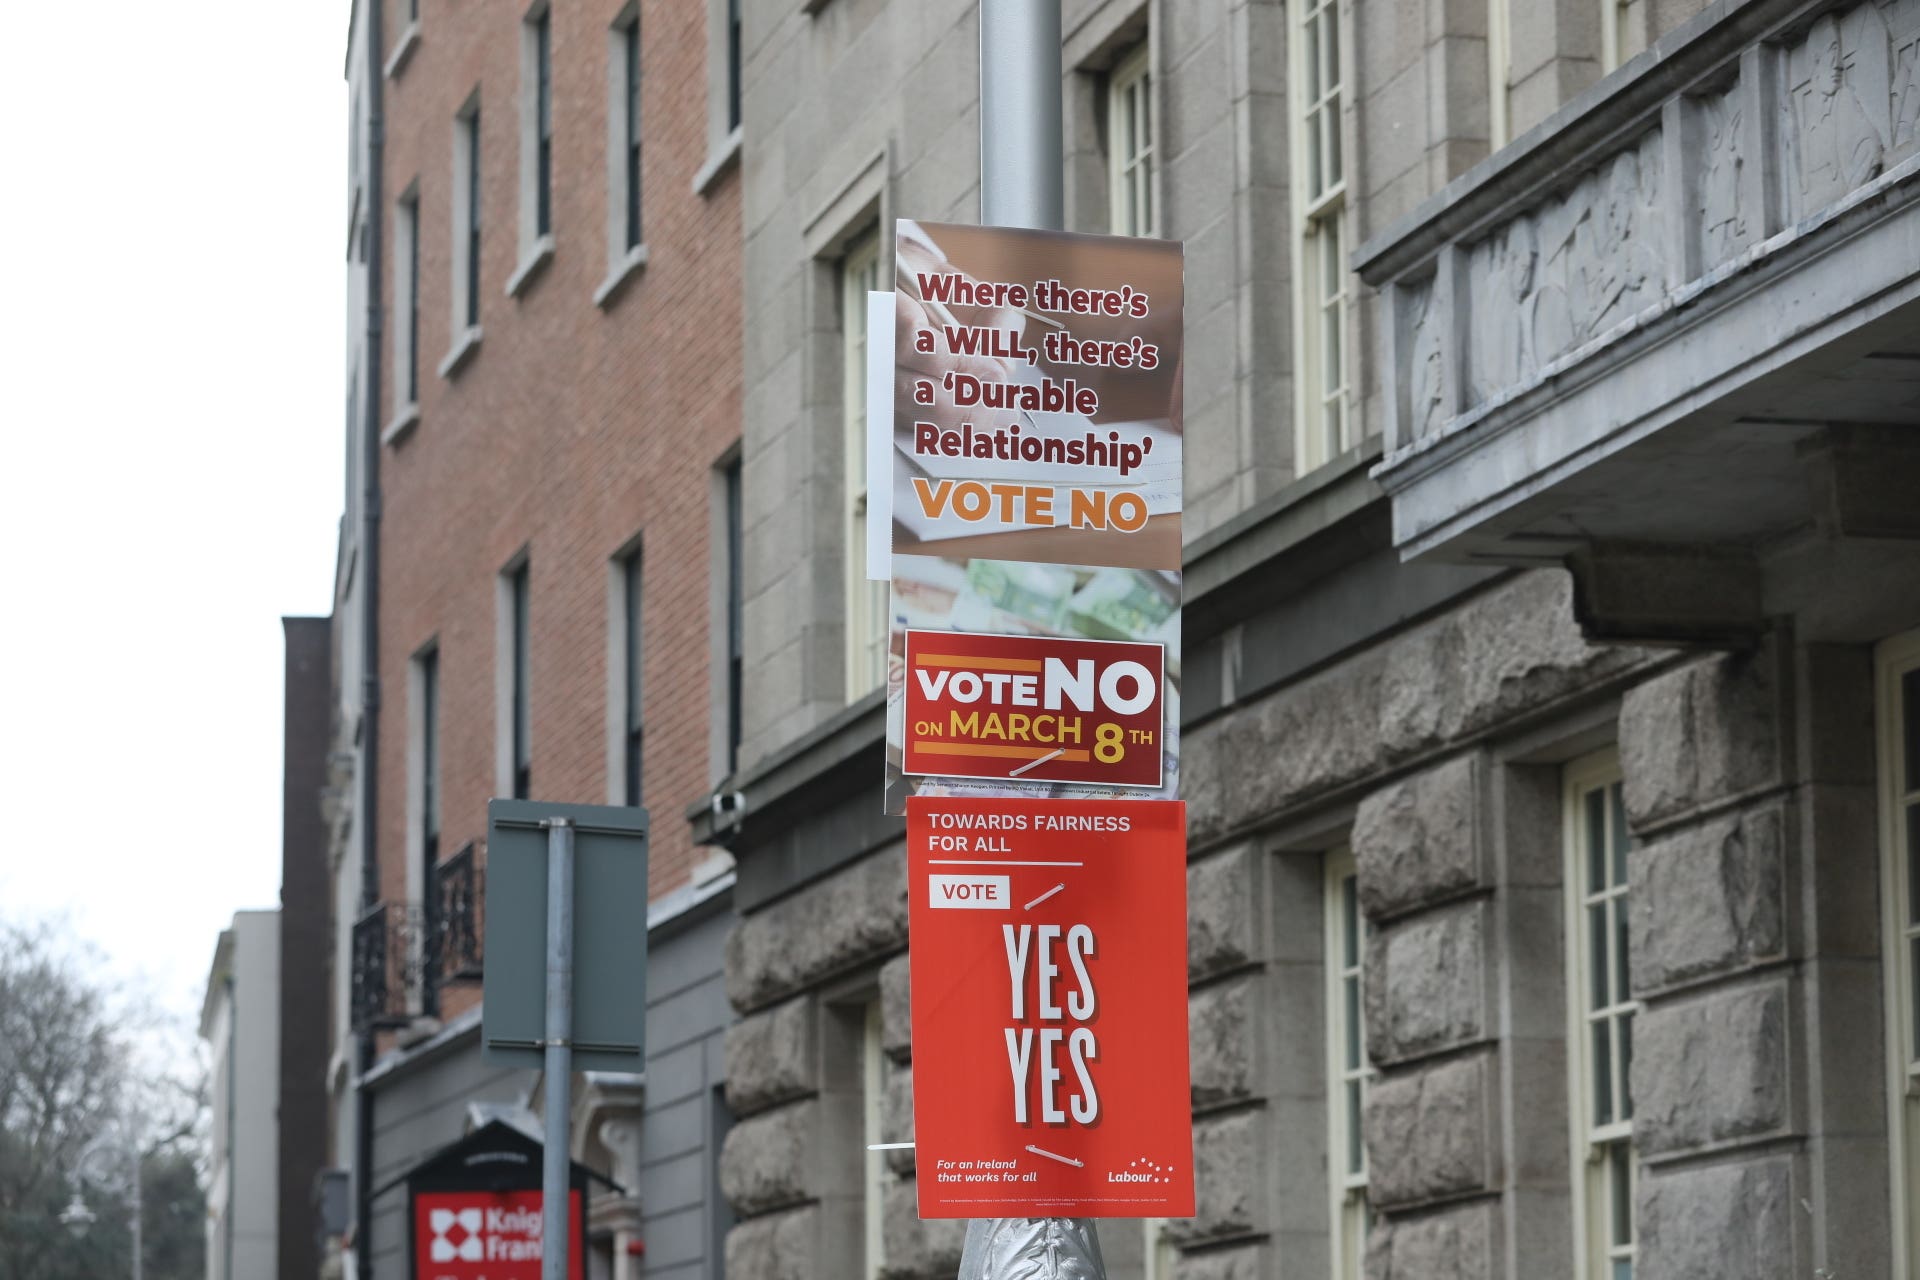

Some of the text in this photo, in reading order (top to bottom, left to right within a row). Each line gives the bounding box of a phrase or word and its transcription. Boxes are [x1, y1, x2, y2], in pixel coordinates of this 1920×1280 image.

[917, 273, 1148, 318] Where there’s
[915, 325, 1158, 369] a WILL, there’s
[914, 372, 1098, 416] a ‘Durable
[914, 422, 1153, 476] Relationship’
[911, 477, 1149, 533] VOTE NO
[915, 657, 1156, 716] VOTE NO
[915, 720, 943, 737] ON
[950, 710, 1082, 744] MARCH
[927, 813, 1131, 832] TOWARDS FAIRNESS
[928, 835, 1012, 852] FOR ALL
[942, 884, 998, 900] VOTE
[1002, 924, 1096, 1022] YES
[1004, 1027, 1099, 1125] YES
[937, 1159, 1017, 1169] For an Ireland
[938, 1171, 1037, 1182] that works for all
[1108, 1171, 1153, 1183] Labour
[485, 1206, 544, 1238] Knig
[486, 1235, 544, 1261] Fran
